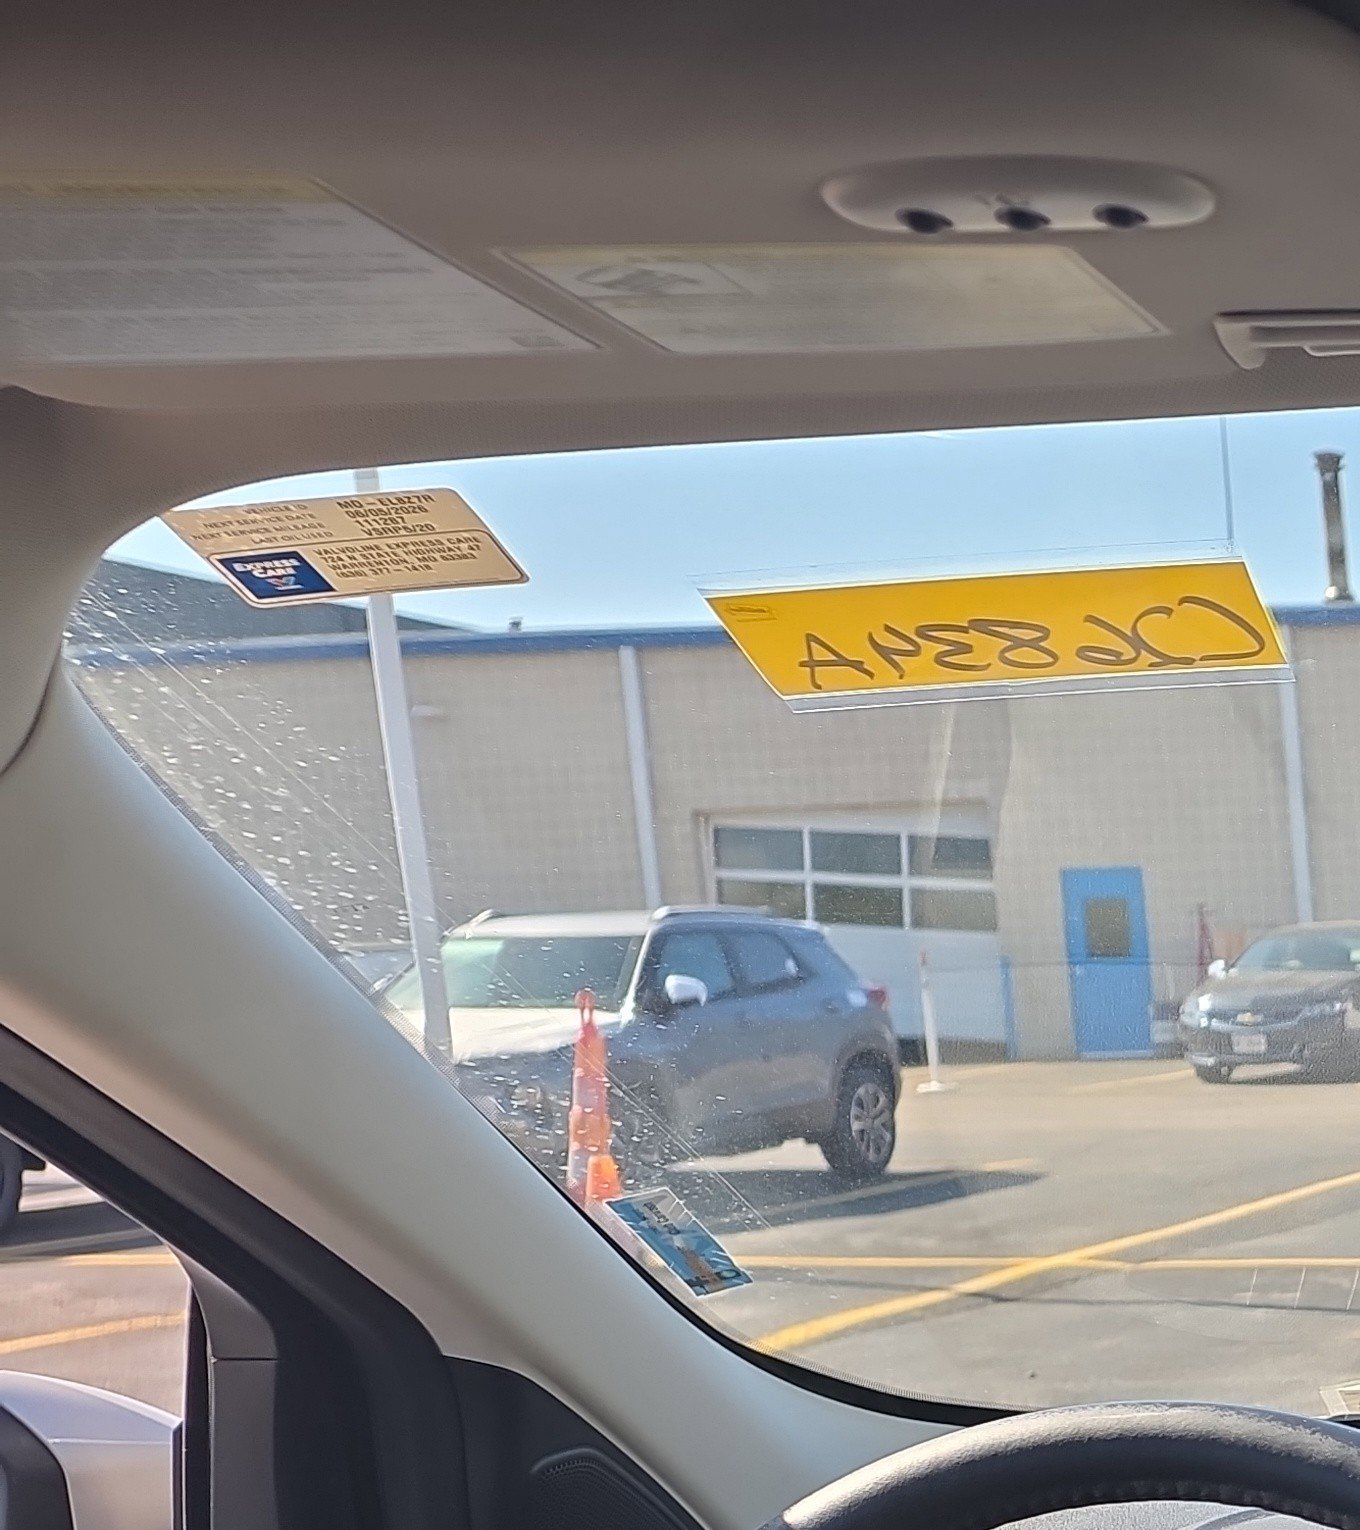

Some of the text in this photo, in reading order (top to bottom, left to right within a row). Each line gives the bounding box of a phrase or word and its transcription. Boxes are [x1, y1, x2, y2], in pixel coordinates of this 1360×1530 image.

[203, 520, 235, 530] NEXT
[285, 512, 317, 522] DATE
[274, 521, 327, 533] MILEAGE
[251, 530, 334, 545] LAST OIL USED
[313, 536, 483, 556] VALVOLINE EXPRESS CARE
[361, 550, 400, 560] STATE
[401, 546, 462, 557] HIGHWAY
[232, 558, 301, 572] EXPRESS
[251, 567, 298, 579] CARE
